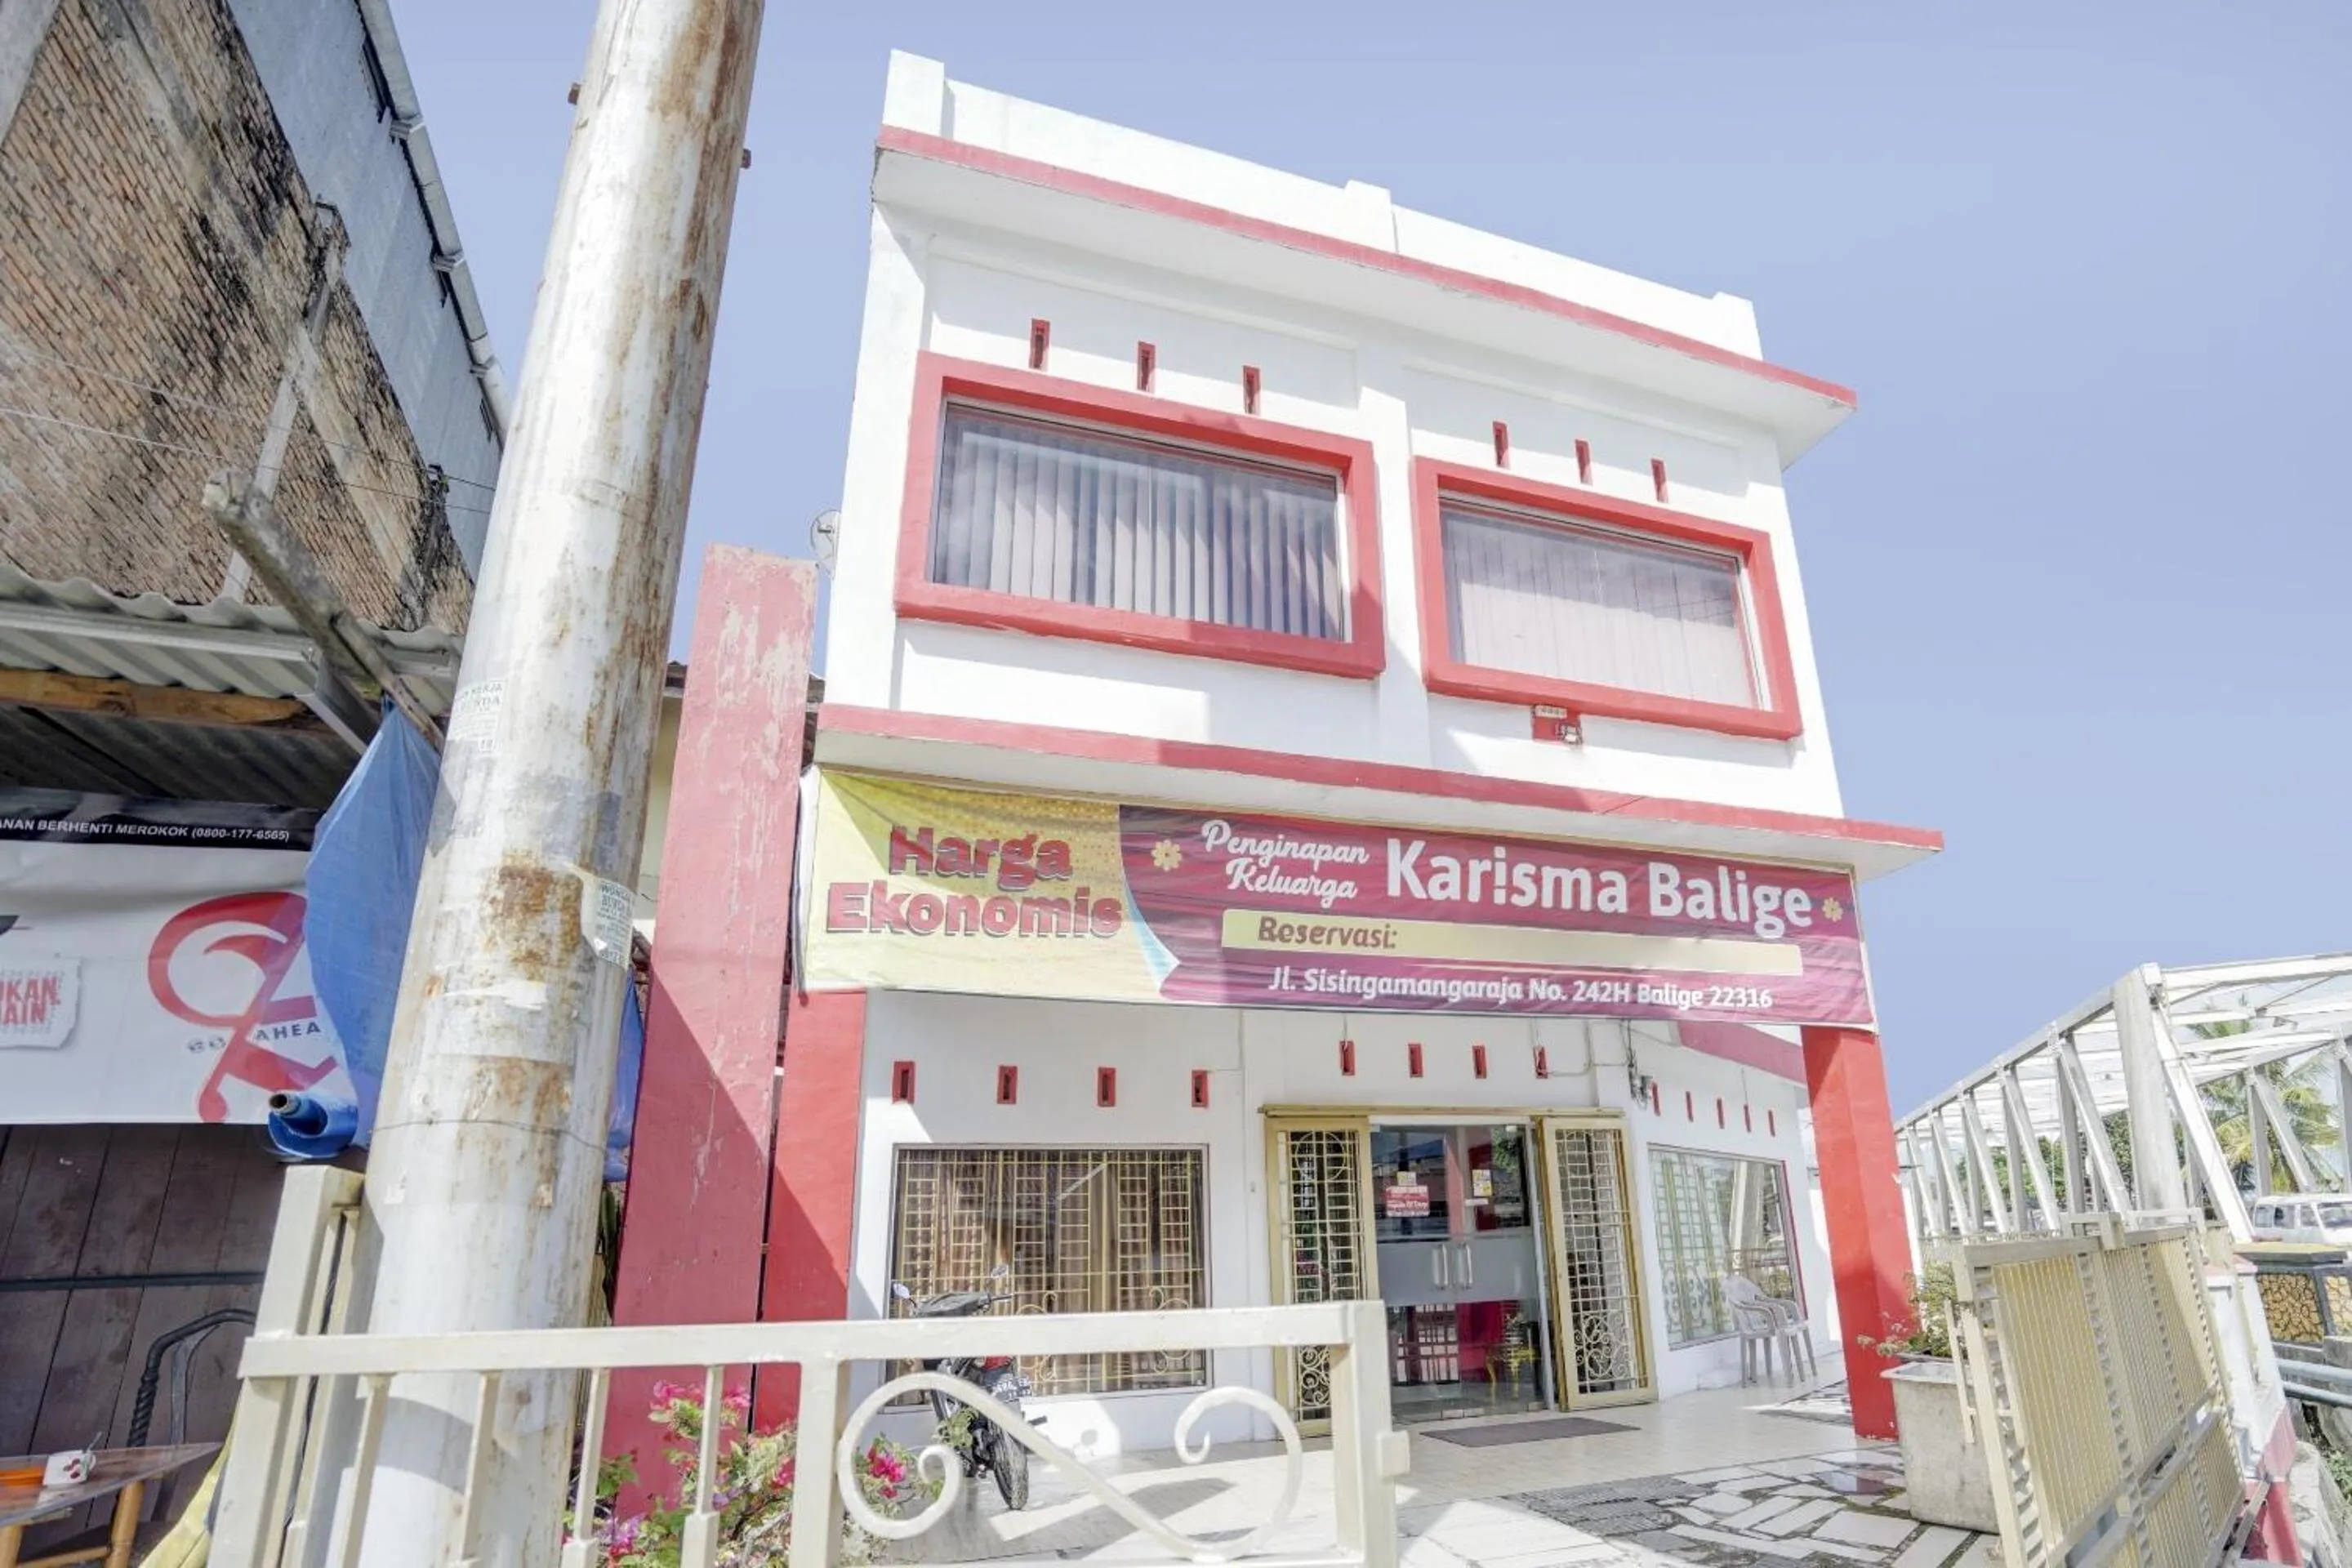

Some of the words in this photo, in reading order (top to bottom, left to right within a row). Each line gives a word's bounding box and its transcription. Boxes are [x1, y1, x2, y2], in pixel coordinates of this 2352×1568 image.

[0, 817, 34, 831] NAN
[37, 819, 113, 833] BERHENTI
[115, 824, 188, 837] MEROKOK
[1201, 819, 1370, 871] Penginapan
[889, 825, 1073, 891] Harga
[1225, 857, 1359, 909] Keluarga
[826, 880, 1124, 938] Ekonomis
[1387, 838, 1629, 914] Karisma
[1648, 862, 1813, 939] Balige
[1257, 915, 1398, 949] Reservasi:
[1267, 965, 1296, 991] Jl.
[1303, 968, 1525, 1004] Sisingamangaraja
[1528, 978, 1567, 1000] No.
[1573, 980, 1631, 1003] 242H
[1637, 982, 1704, 1010] Balige
[1709, 985, 1773, 1008] 22316
